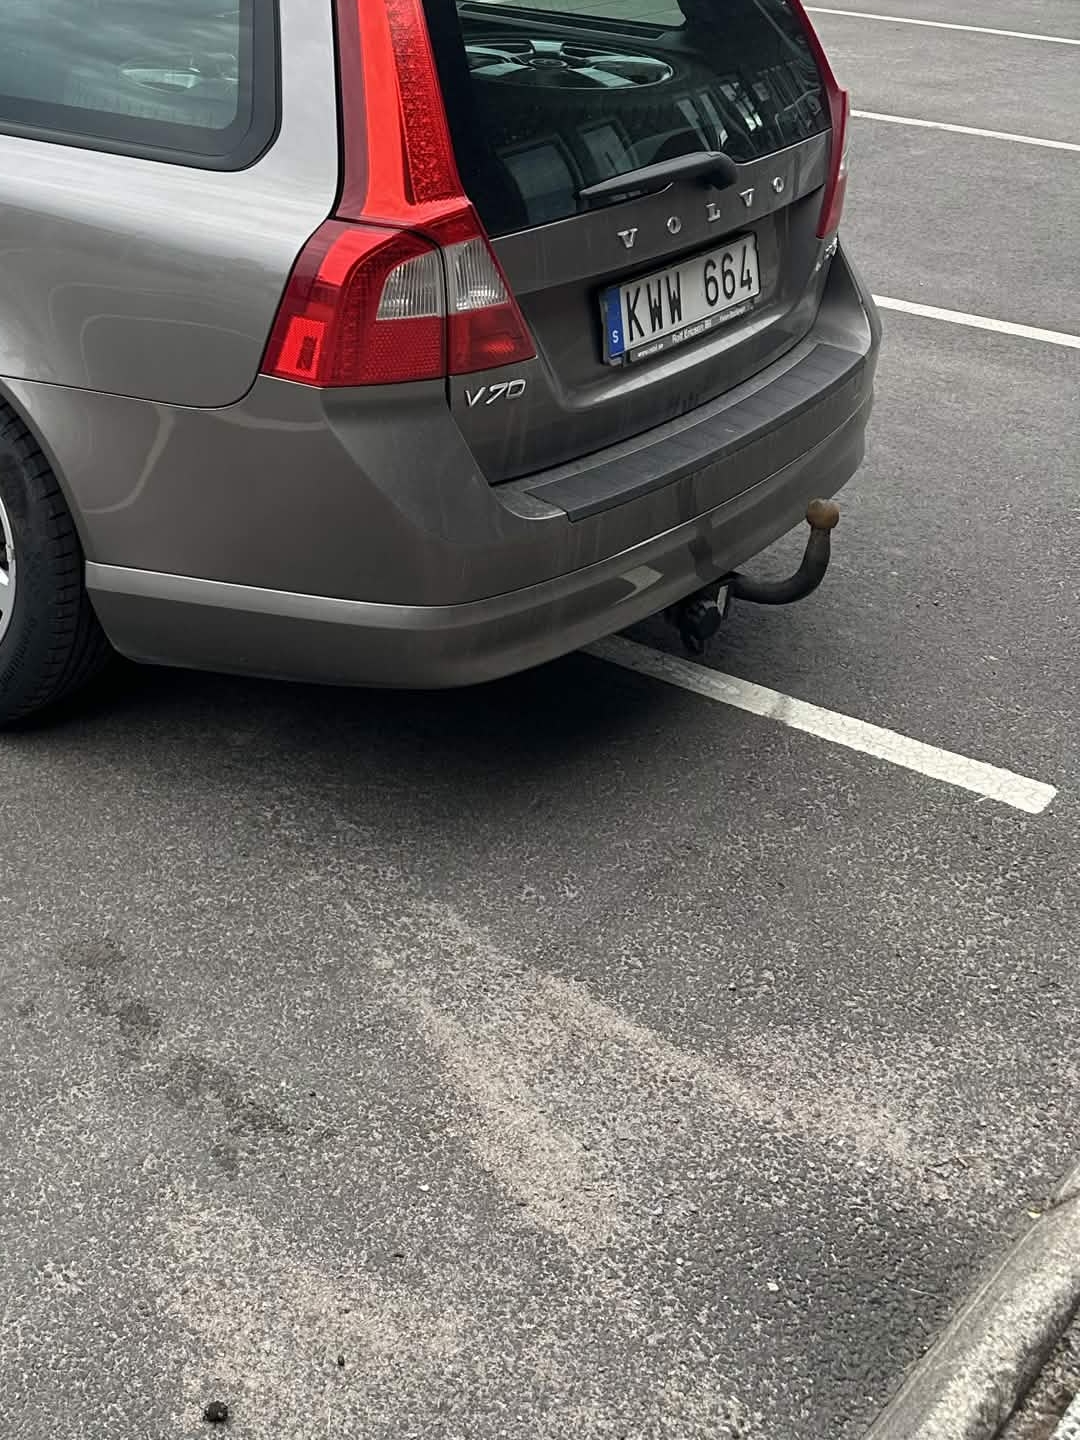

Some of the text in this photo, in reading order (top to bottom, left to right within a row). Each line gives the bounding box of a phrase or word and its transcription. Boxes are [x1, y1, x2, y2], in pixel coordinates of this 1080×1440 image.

[617, 176, 785, 248] VOLVO
[626, 272, 683, 343] KWW
[704, 244, 753, 307] 664
[612, 330, 620, 344] S
[465, 378, 526, 408] V70
